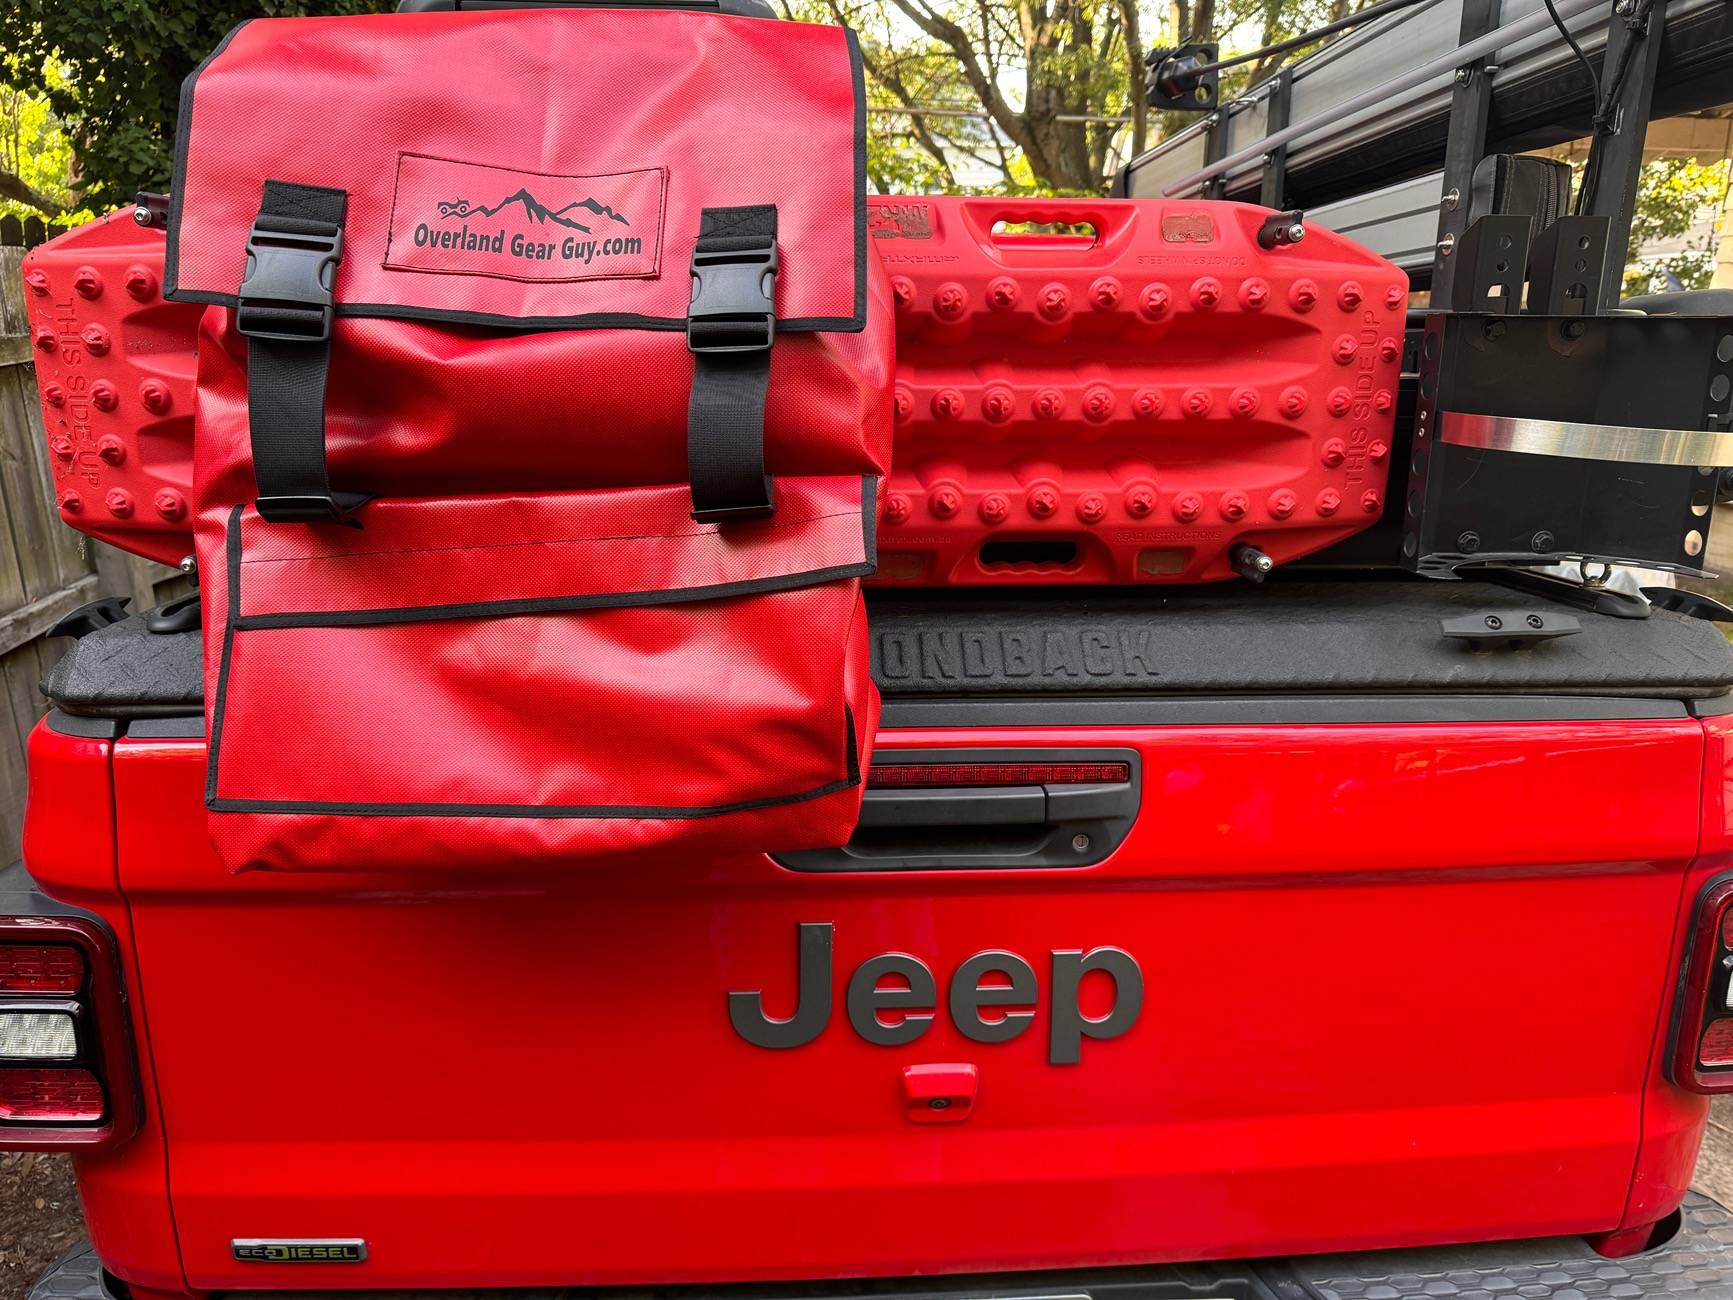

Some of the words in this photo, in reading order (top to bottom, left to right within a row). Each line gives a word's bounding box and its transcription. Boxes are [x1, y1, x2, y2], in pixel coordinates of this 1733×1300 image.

[414, 223, 505, 253] Overland
[510, 234, 556, 260] Gear
[561, 236, 642, 264] Guy.com
[55, 298, 82, 367] THIS
[1360, 310, 1380, 349] UP
[66, 375, 92, 441] SIDE
[1354, 355, 1377, 422] SIDE
[78, 451, 101, 489] UP
[1344, 426, 1369, 491] THIS
[728, 922, 1144, 1065] Jeep
